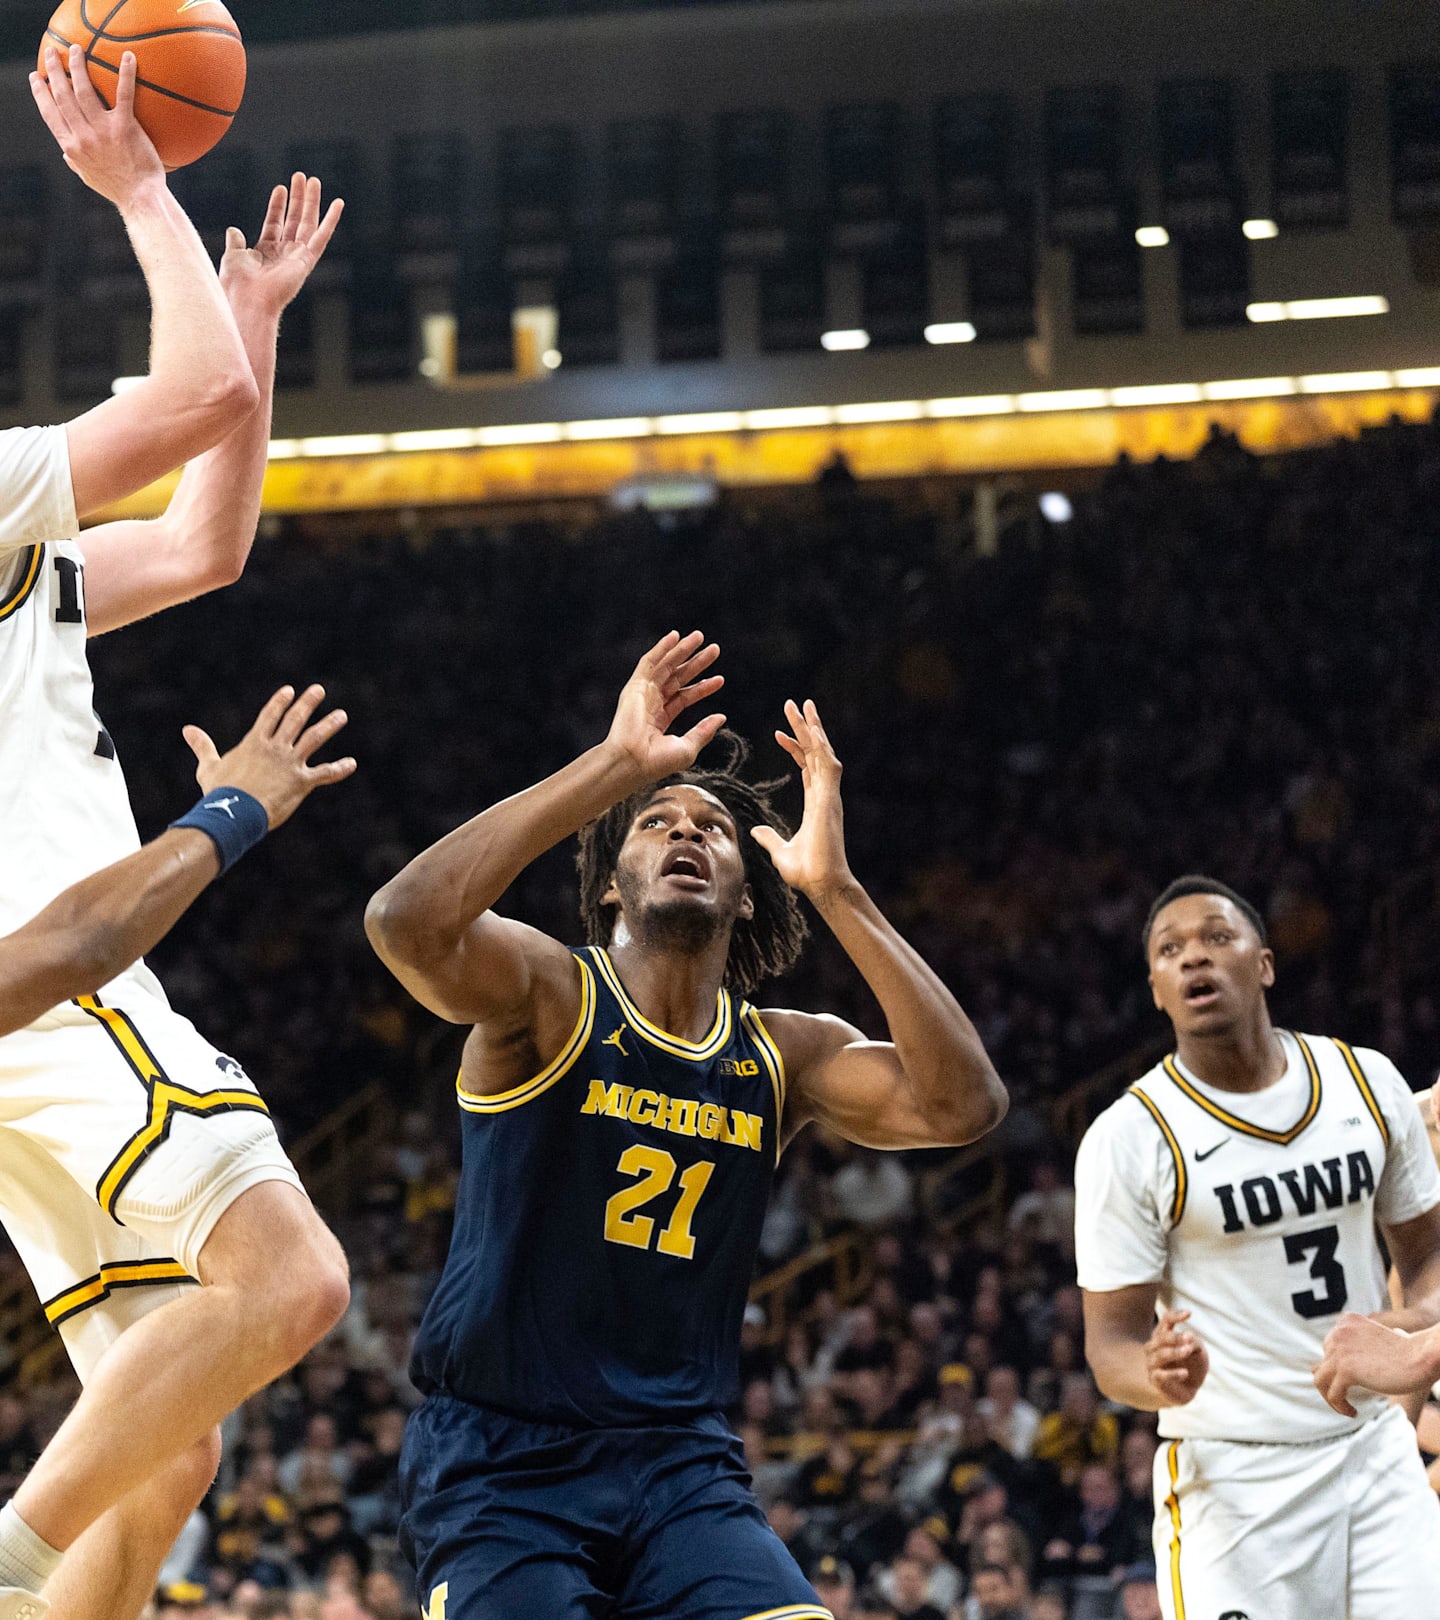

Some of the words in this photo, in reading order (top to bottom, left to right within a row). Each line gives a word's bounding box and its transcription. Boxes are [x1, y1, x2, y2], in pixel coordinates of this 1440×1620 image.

[720, 1058, 759, 1077] BIG
[580, 1080, 764, 1153] MICHIGAN
[604, 1144, 716, 1260] 21
[1214, 1150, 1375, 1235] IOWA
[1283, 1225, 1349, 1320] 3
